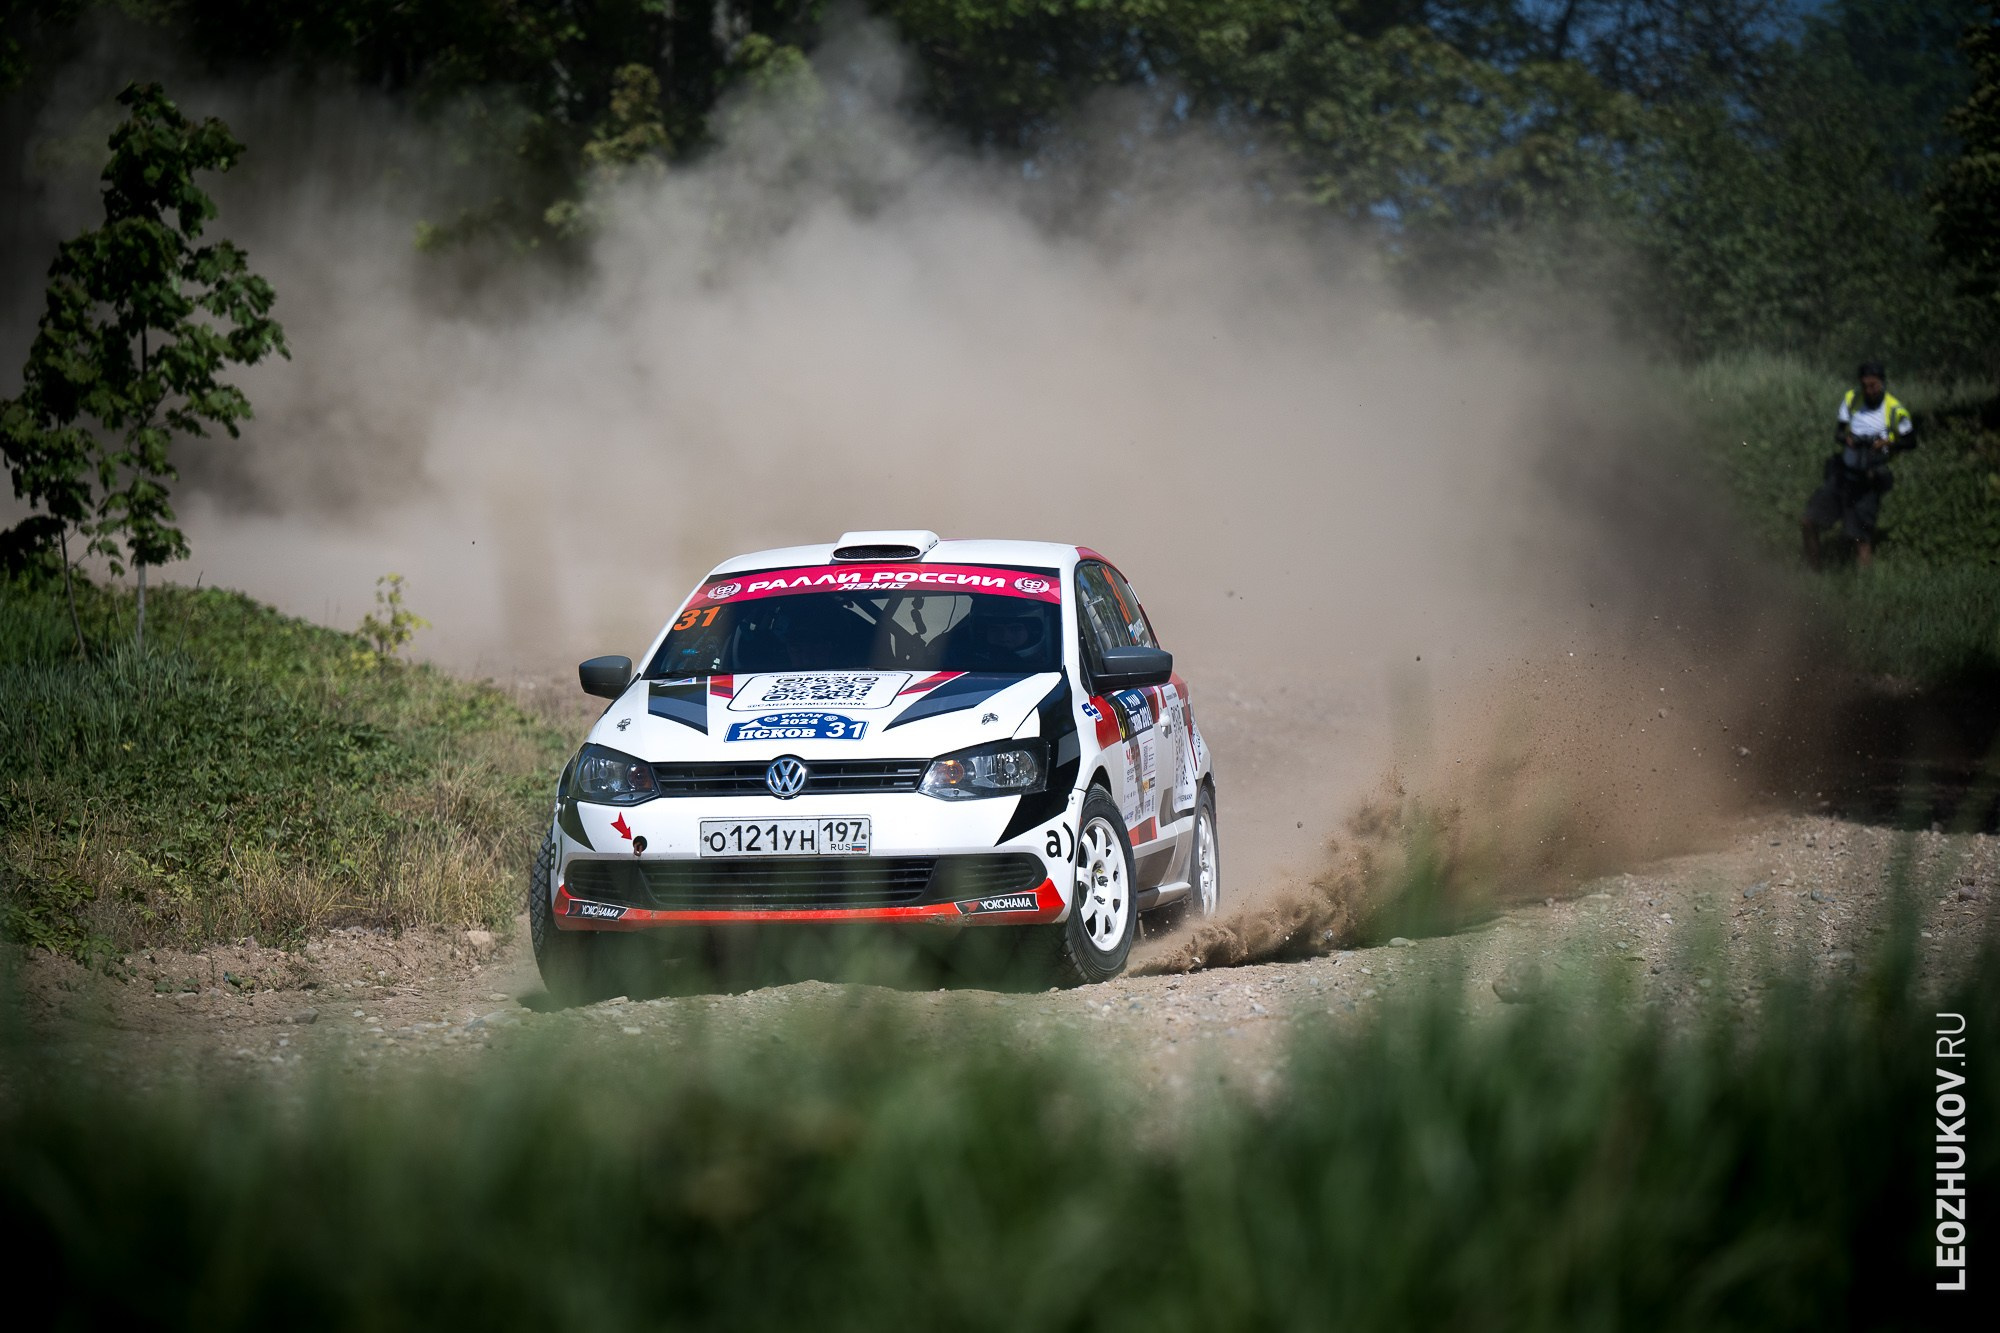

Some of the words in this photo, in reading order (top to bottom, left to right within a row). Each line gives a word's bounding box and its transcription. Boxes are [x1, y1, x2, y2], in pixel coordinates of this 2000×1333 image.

[747, 572, 862, 593] РАЛЛИ
[871, 571, 1006, 588] РОССИИ
[673, 606, 721, 631] 31
[736, 728, 817, 739] ПСКОВ
[825, 722, 864, 738] 31
[822, 821, 862, 842] 197
[830, 843, 851, 851] RUS
[581, 904, 619, 917] YOKOHAMA
[980, 897, 1033, 910] YOKOHAMA
